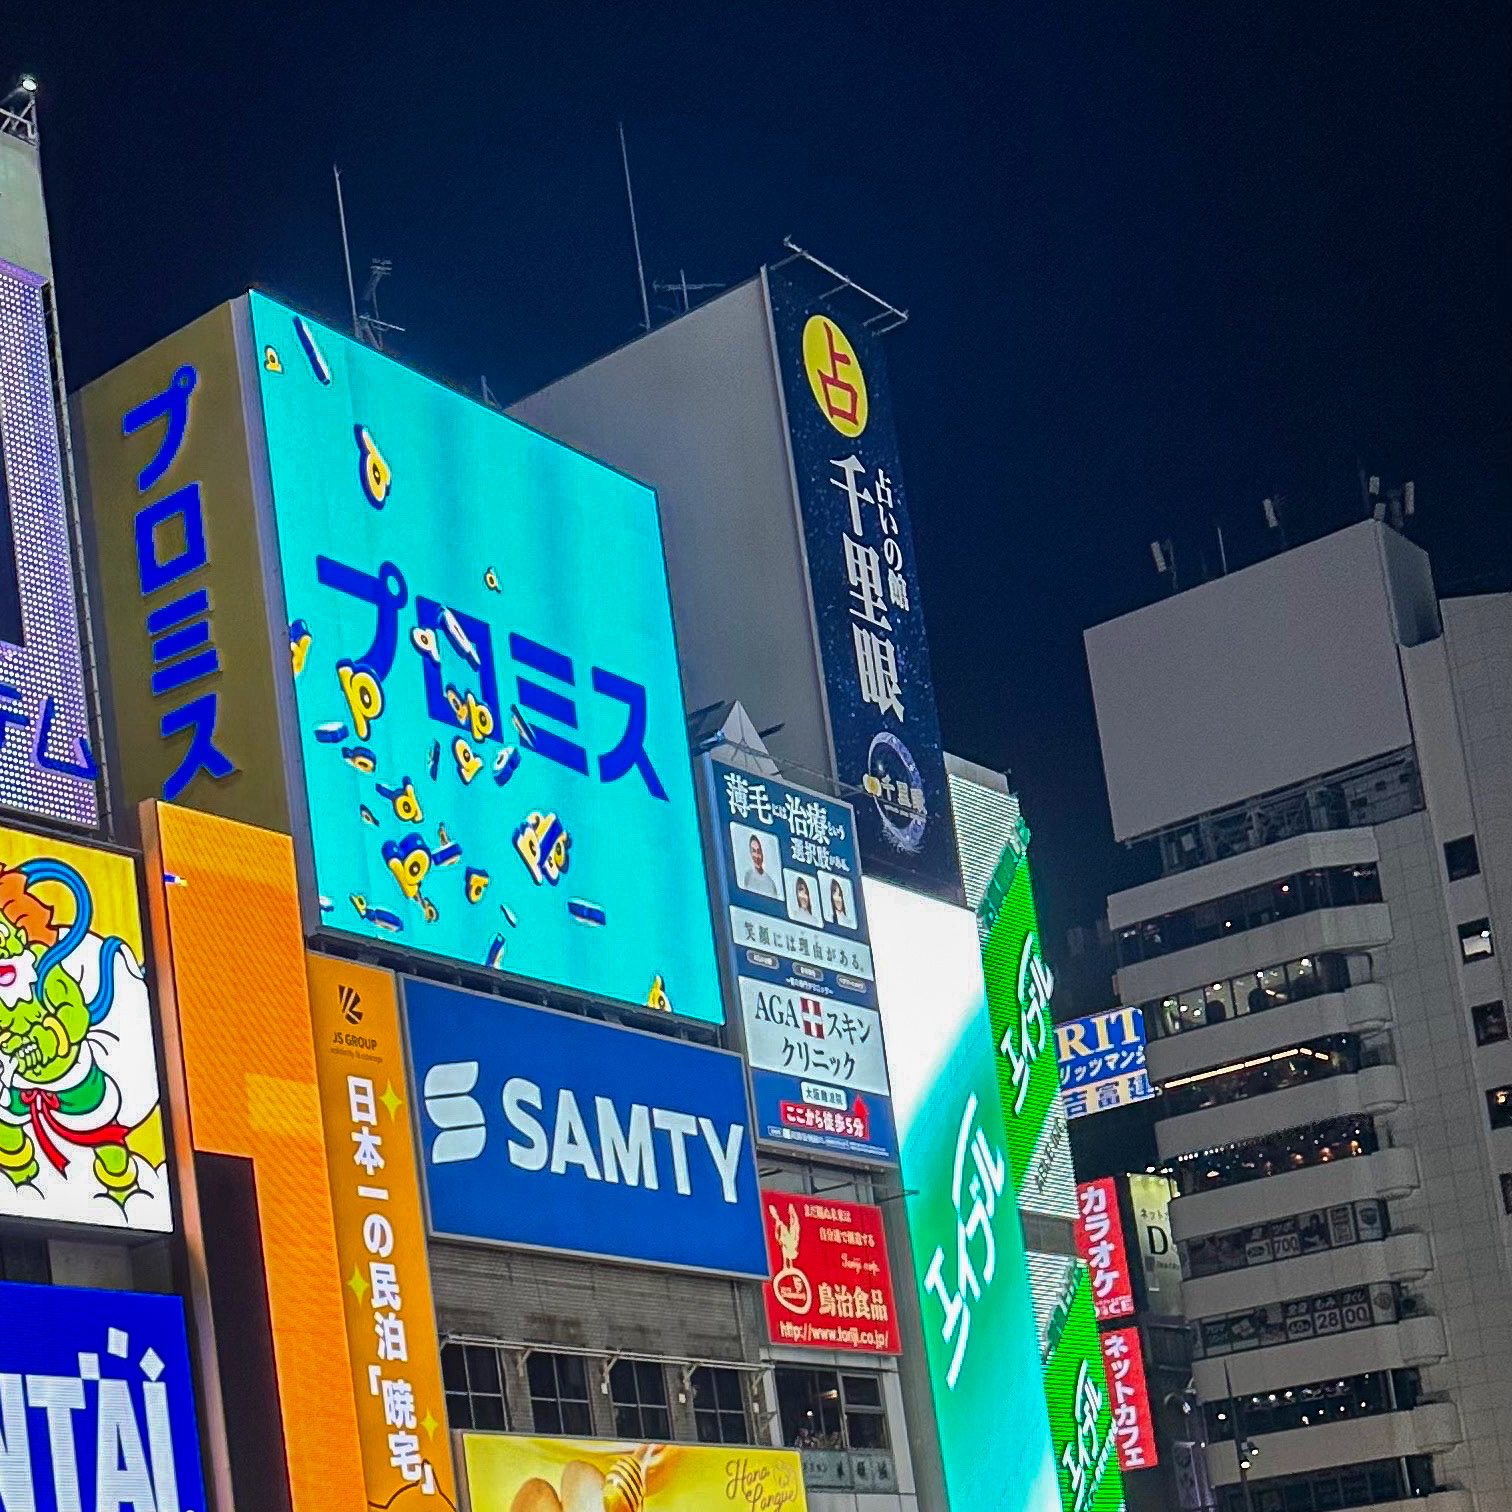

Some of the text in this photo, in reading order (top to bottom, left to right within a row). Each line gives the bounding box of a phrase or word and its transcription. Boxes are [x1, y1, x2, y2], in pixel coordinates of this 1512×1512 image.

[815, 319, 859, 427] 占
[122, 364, 241, 801] プロミス
[829, 454, 906, 723] 千里眼
[874, 467, 910, 613] 占いの館
[316, 554, 669, 802] プロミス
[345, 1033, 377, 1051] GROUP
[755, 991, 870, 1045] AGA スキン
[782, 1036, 855, 1080] クリニック
[502, 1077, 744, 1204] SAMTY
[1080, 1185, 1119, 1298] カラオケ
[1104, 1334, 1145, 1467] ネットカフェ
